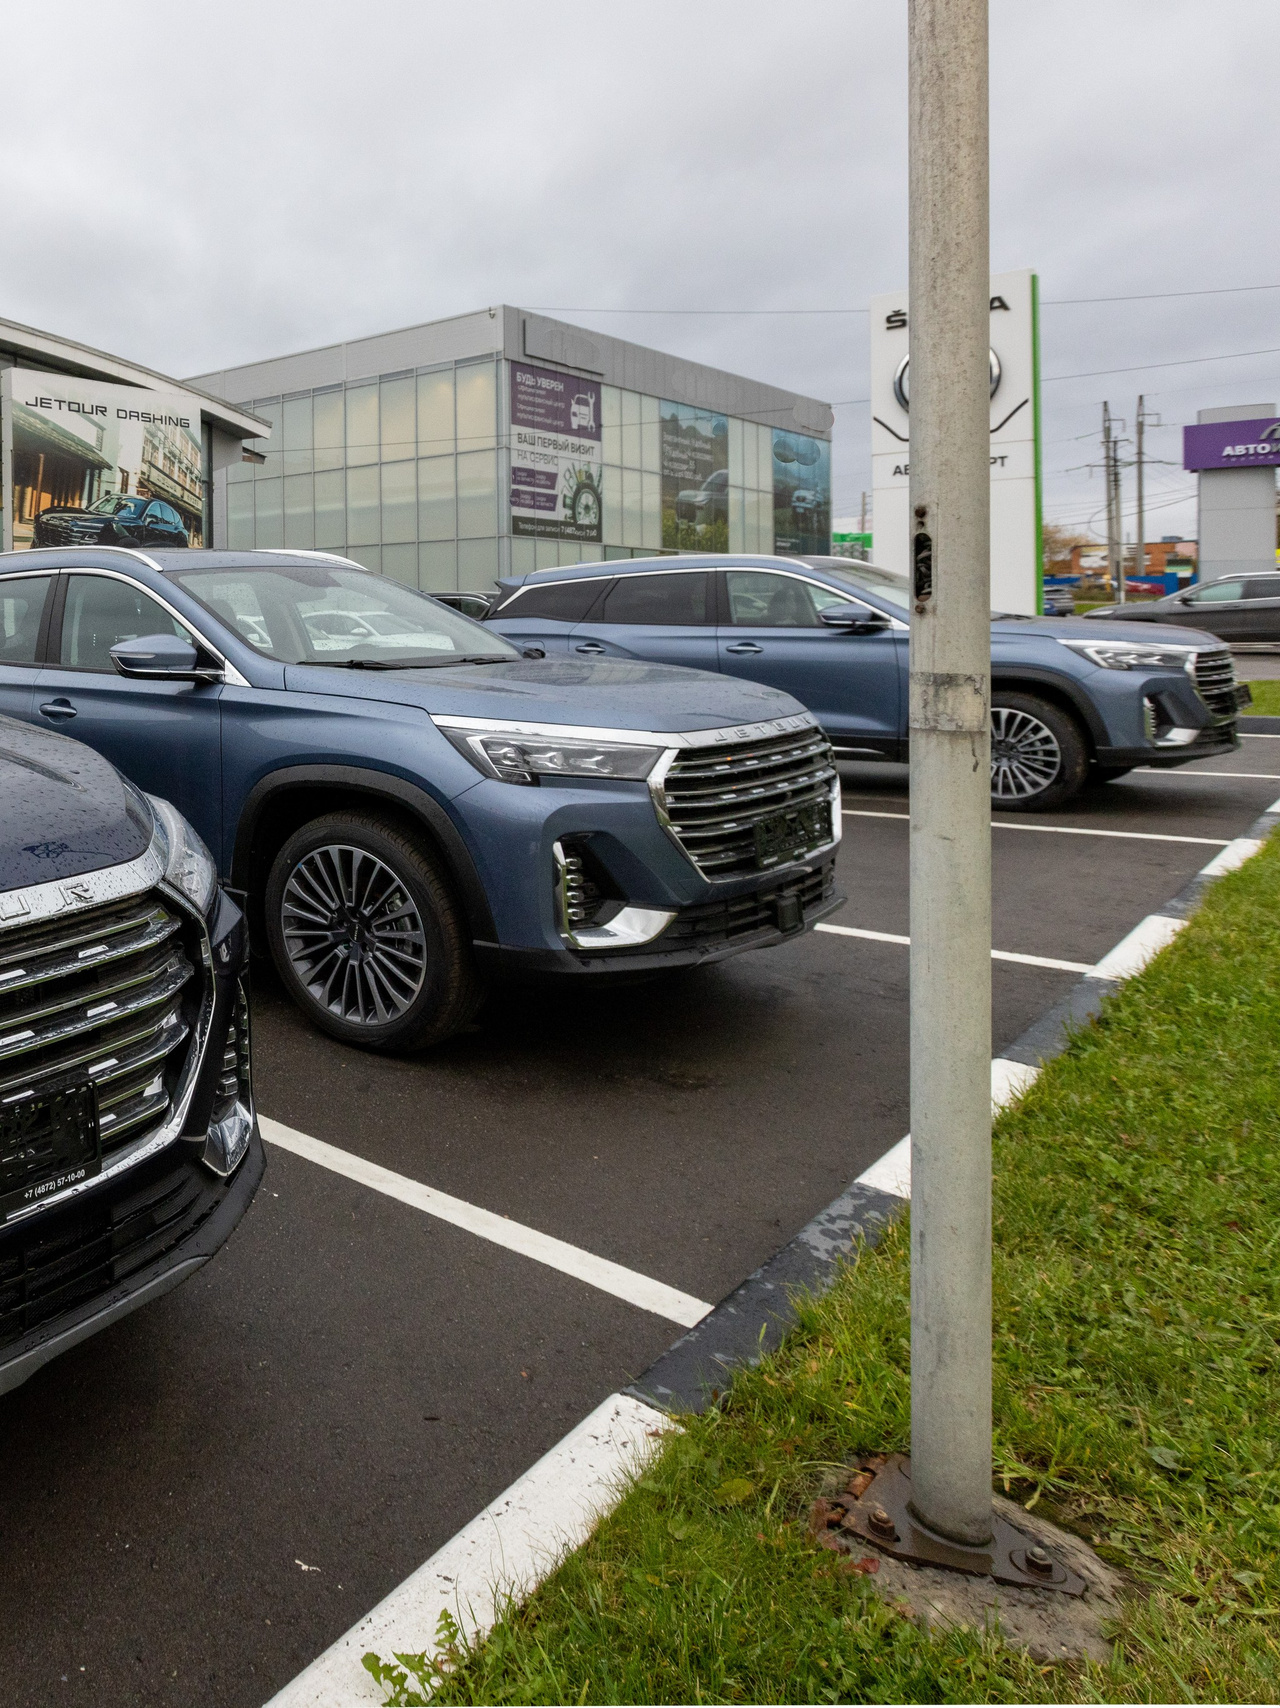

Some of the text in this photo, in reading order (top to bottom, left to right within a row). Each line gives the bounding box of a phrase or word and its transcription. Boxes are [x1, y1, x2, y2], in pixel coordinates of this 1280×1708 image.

[516, 371, 536, 386] БУДЬ
[536, 376, 565, 392] УВЕРЕН
[25, 396, 190, 429] JETOUR DASHING
[517, 432, 595, 457] ВАШ ПЕРВЫЙ ВИЗИТ
[517, 449, 559, 467] НА СЕРВИС
[23, 1169, 86, 1199] +7 (4872) 57-10-00
